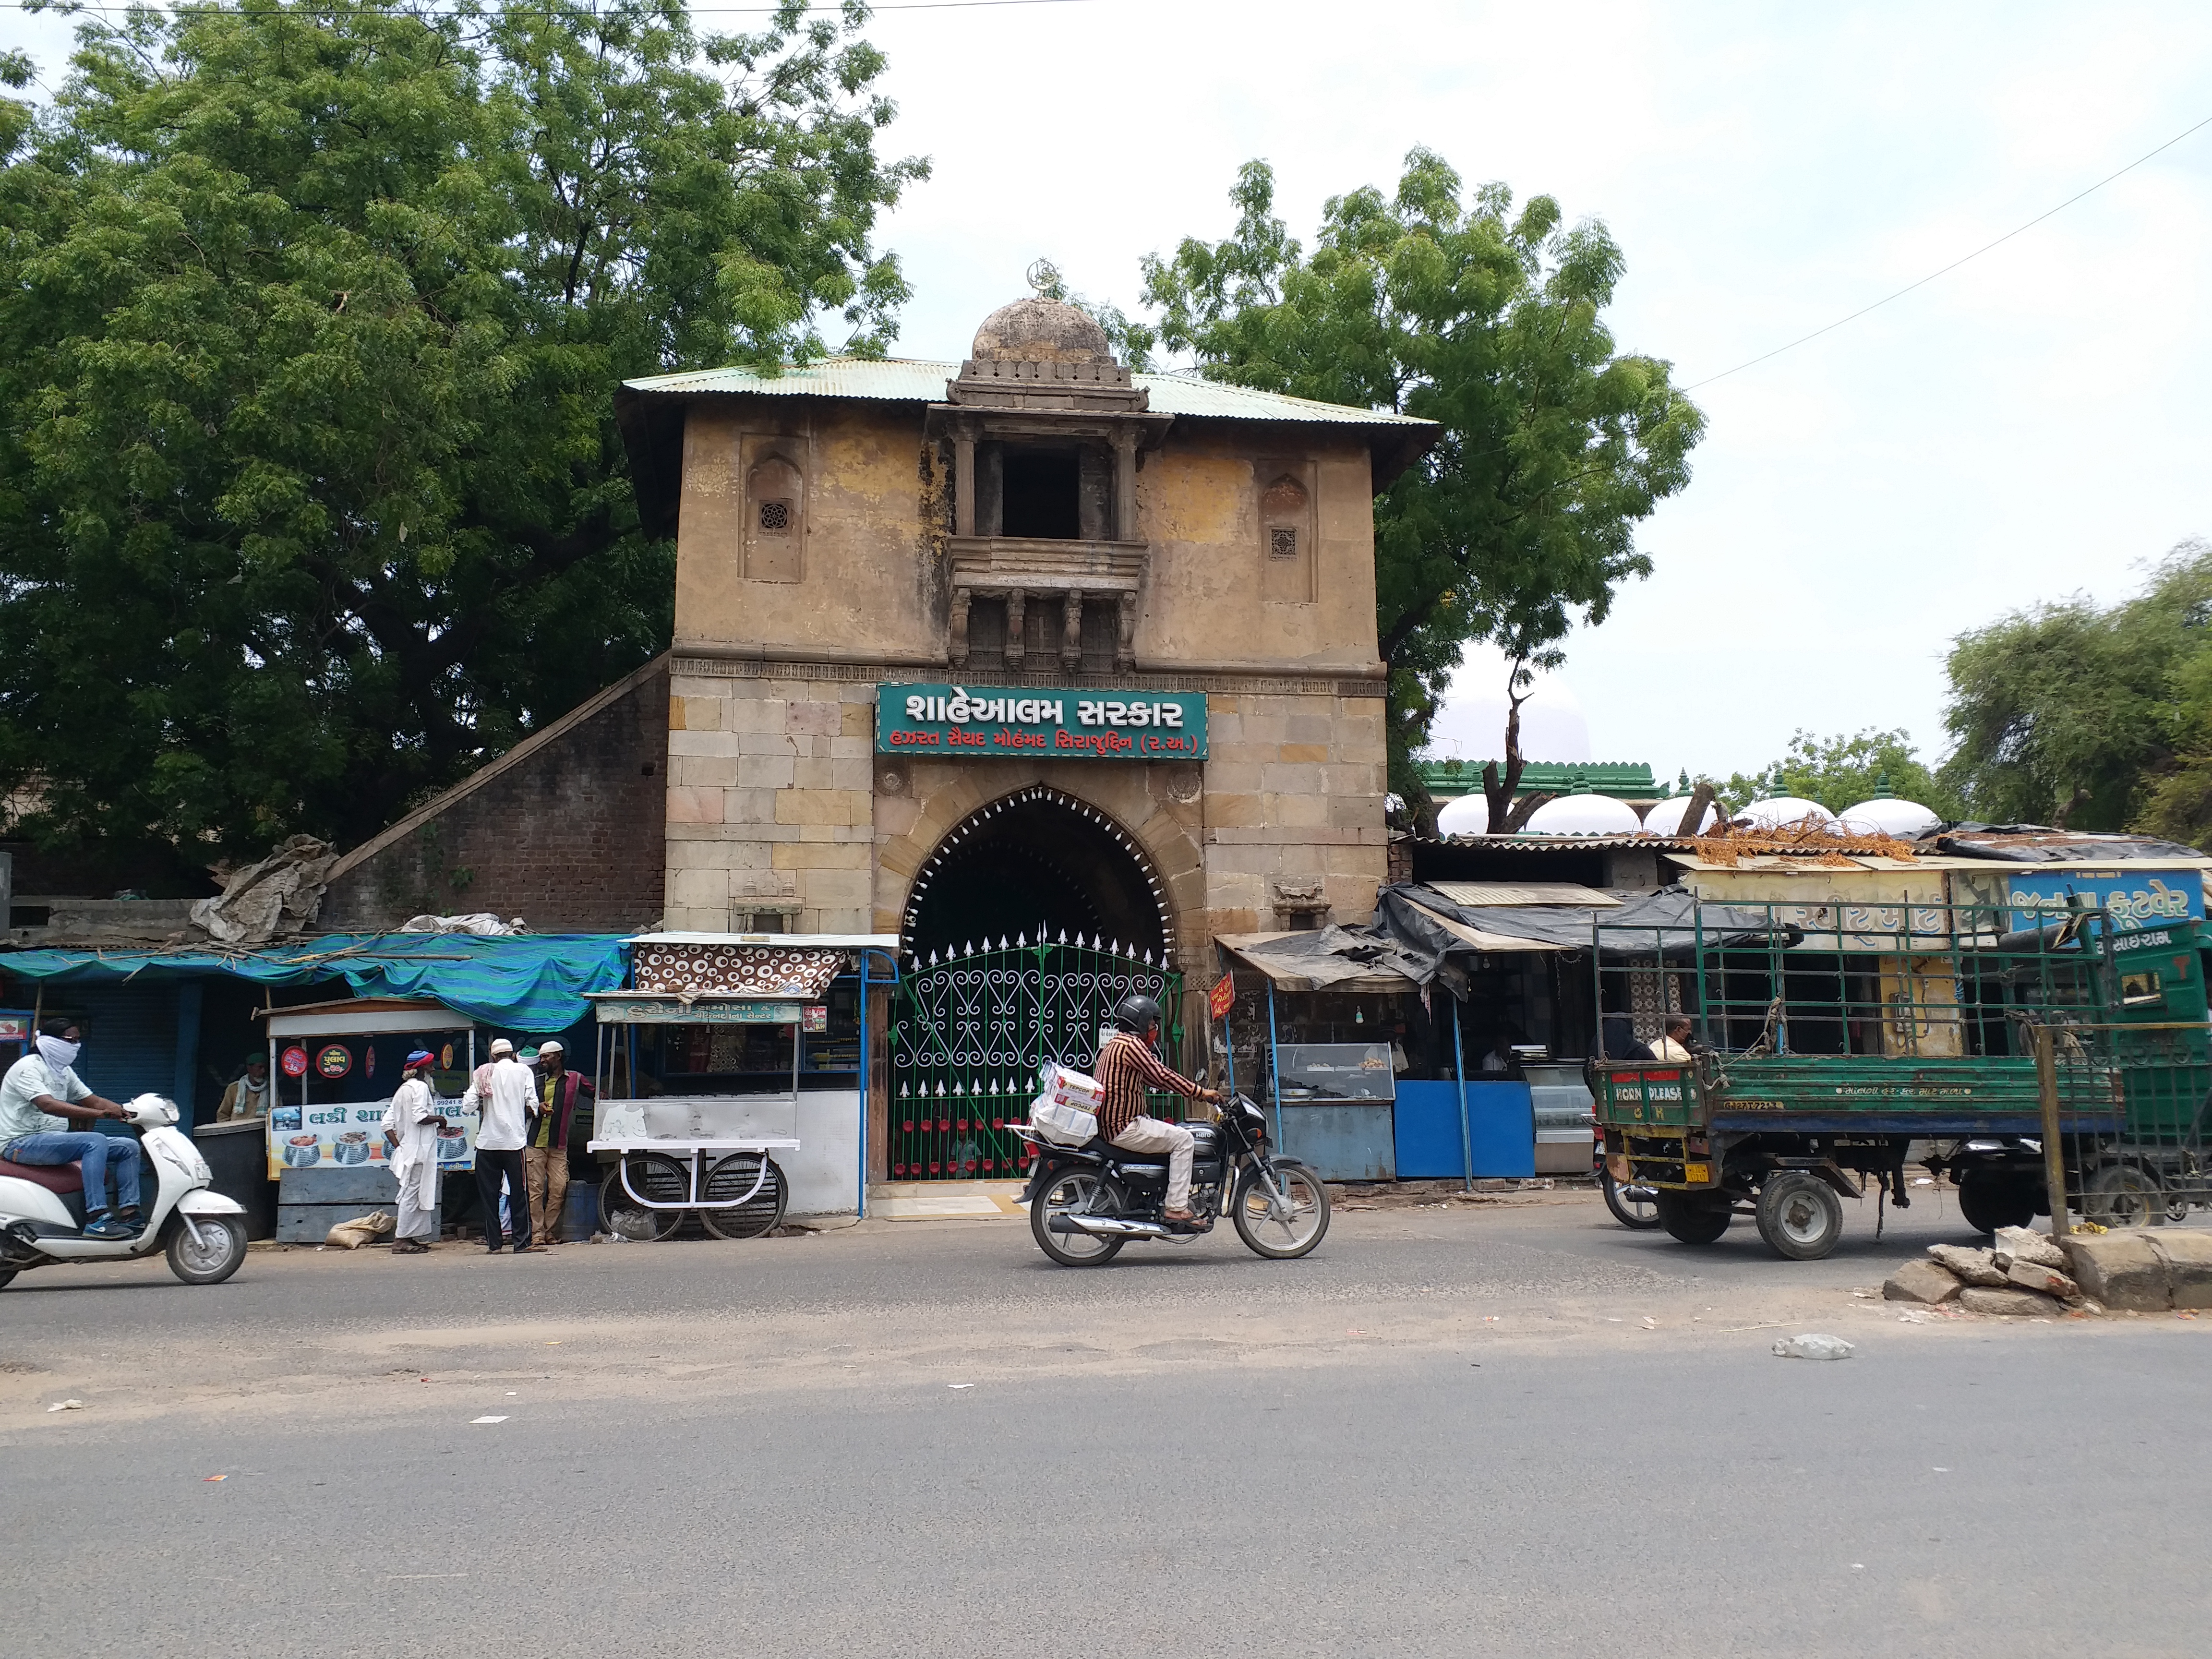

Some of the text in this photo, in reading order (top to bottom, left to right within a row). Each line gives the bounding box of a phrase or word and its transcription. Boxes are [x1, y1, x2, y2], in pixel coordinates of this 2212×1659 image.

[906, 686, 1184, 728] શાહેઆલમ સરકાર
[889, 729, 940, 745] હઝરત
[947, 726, 986, 746] સૈયદ
[993, 727, 1047, 748] મોહંમદ
[1616, 1086, 1683, 1101] HORN PLEASE
[309, 1106, 348, 1125] લકી
